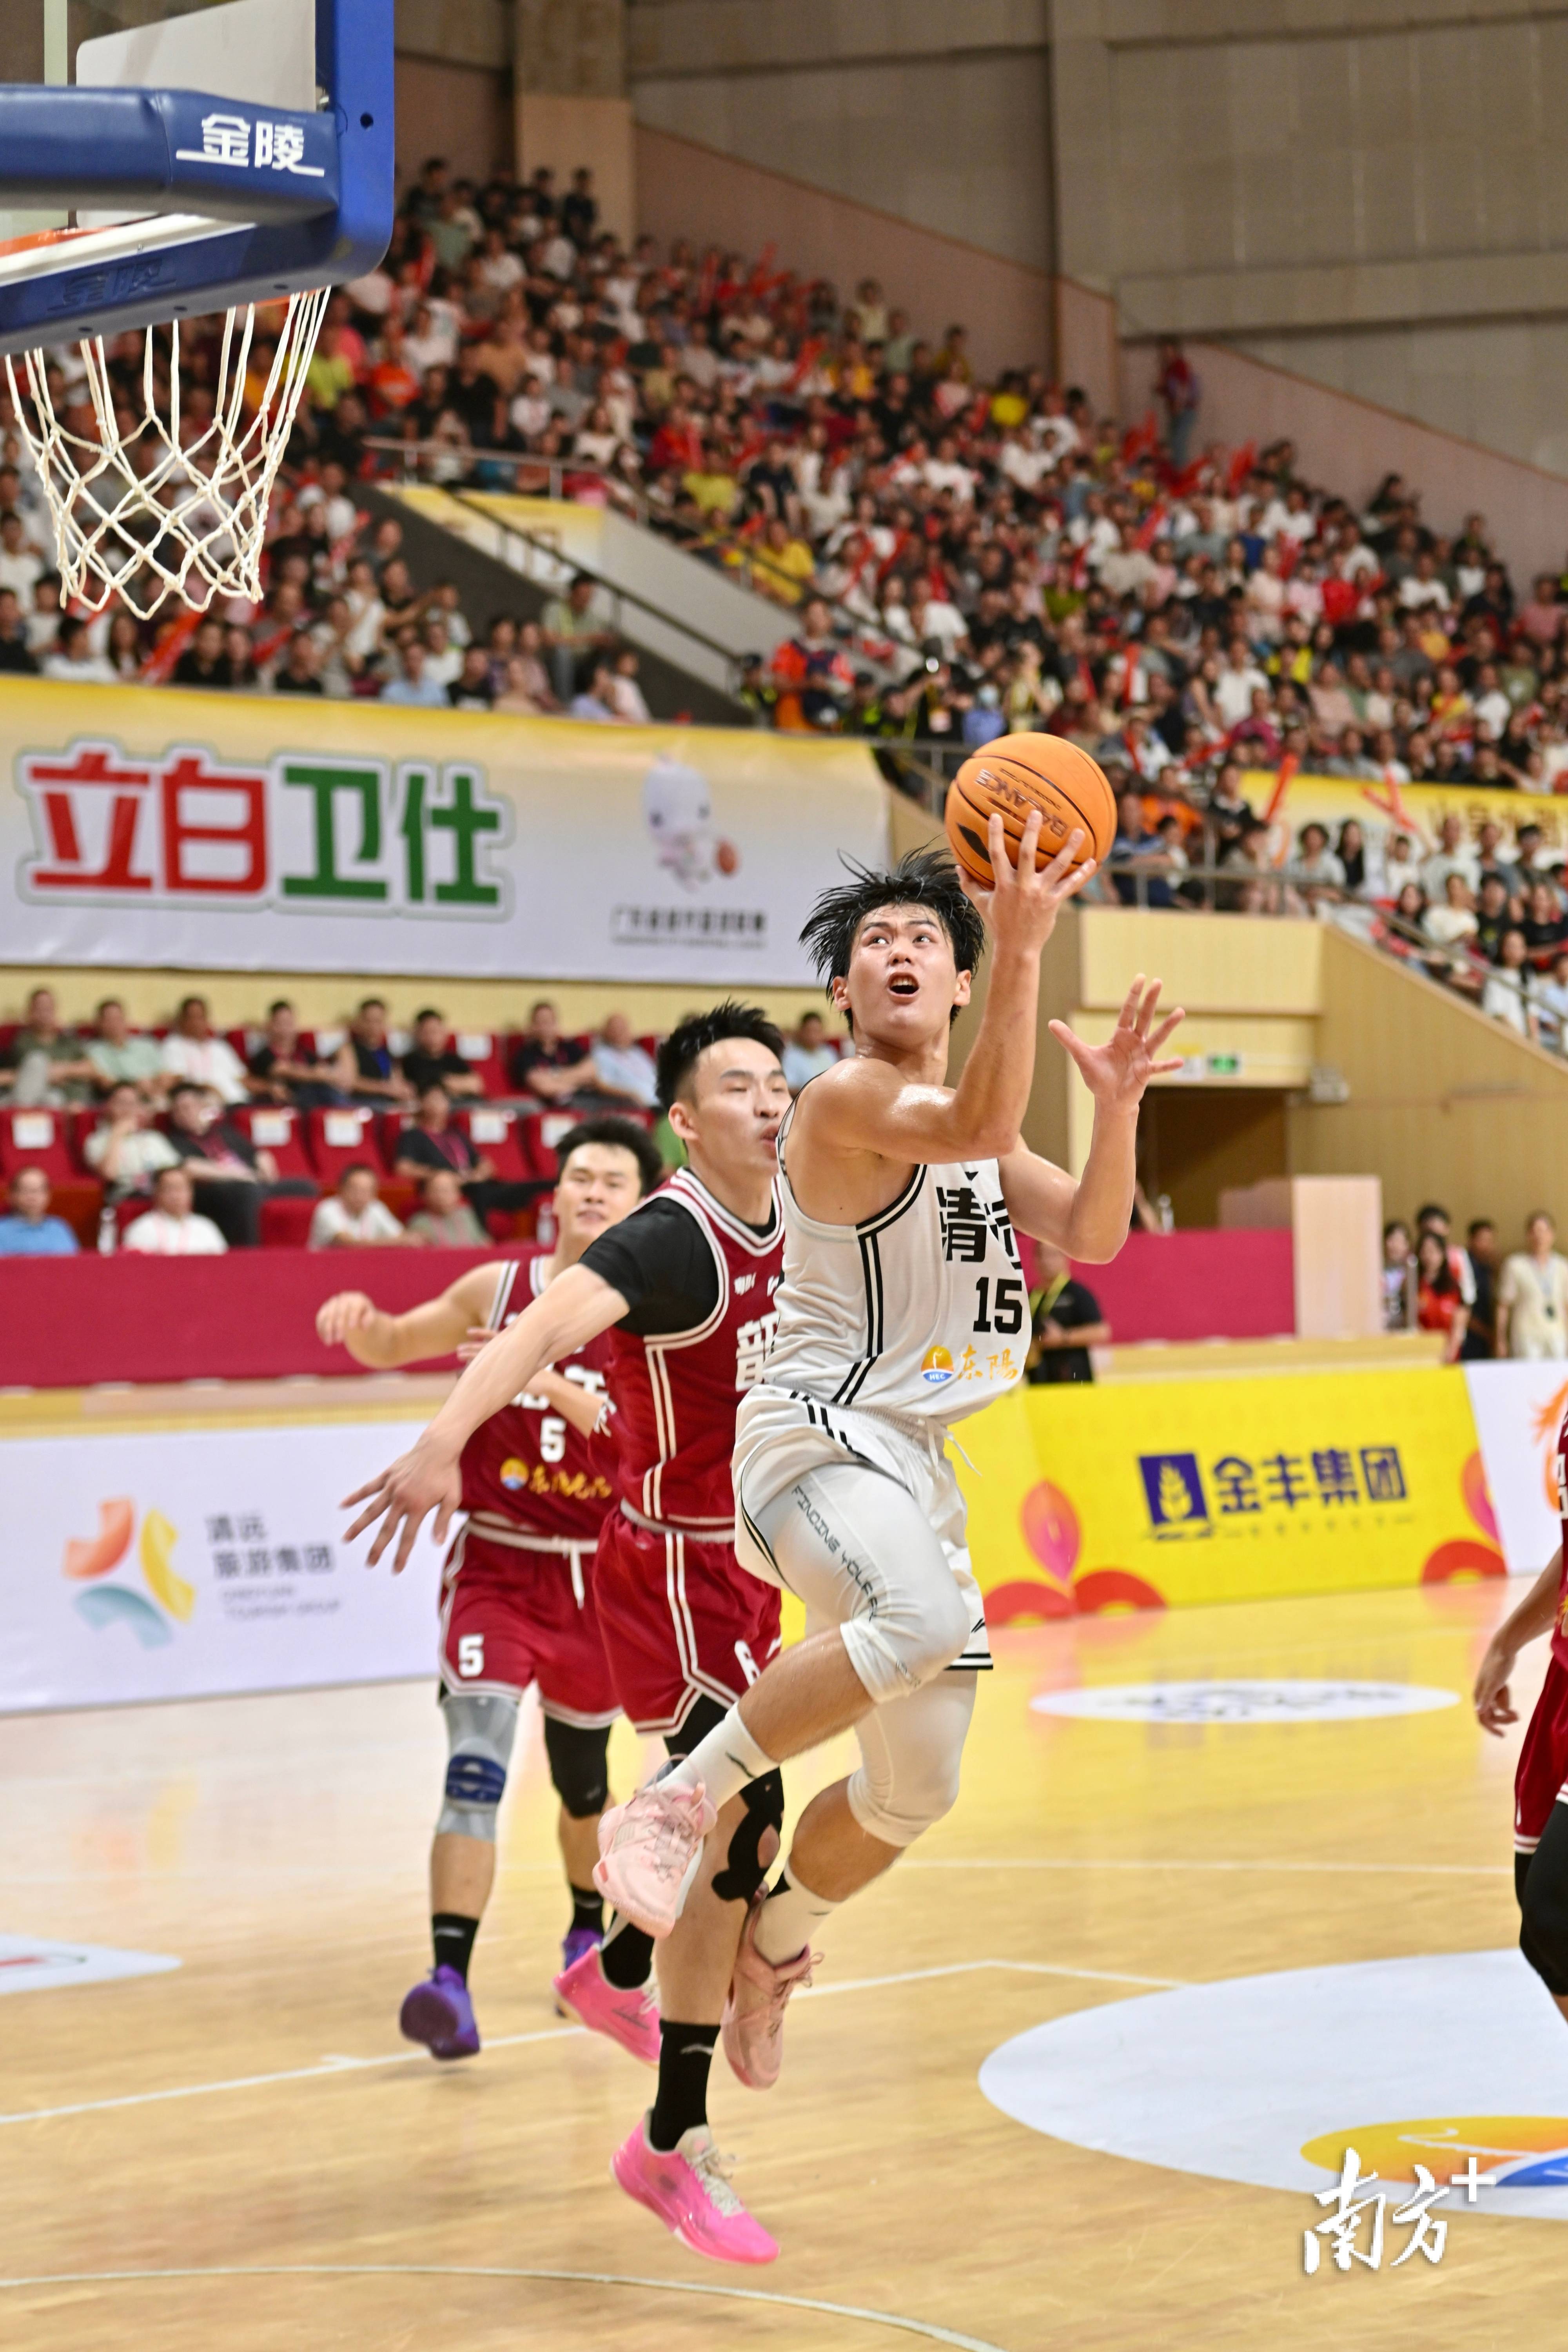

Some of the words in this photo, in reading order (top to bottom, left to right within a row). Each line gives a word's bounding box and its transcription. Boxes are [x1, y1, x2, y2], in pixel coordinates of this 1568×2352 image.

[176, 113, 325, 177] 金陵
[28, 751, 500, 904] 立白卫仕
[973, 1276, 1022, 1335] 15
[540, 1416, 567, 1463] 5
[1213, 1446, 1408, 1514] 金丰集团
[791, 1485, 840, 1553] FINDING
[458, 1634, 485, 1678] 5
